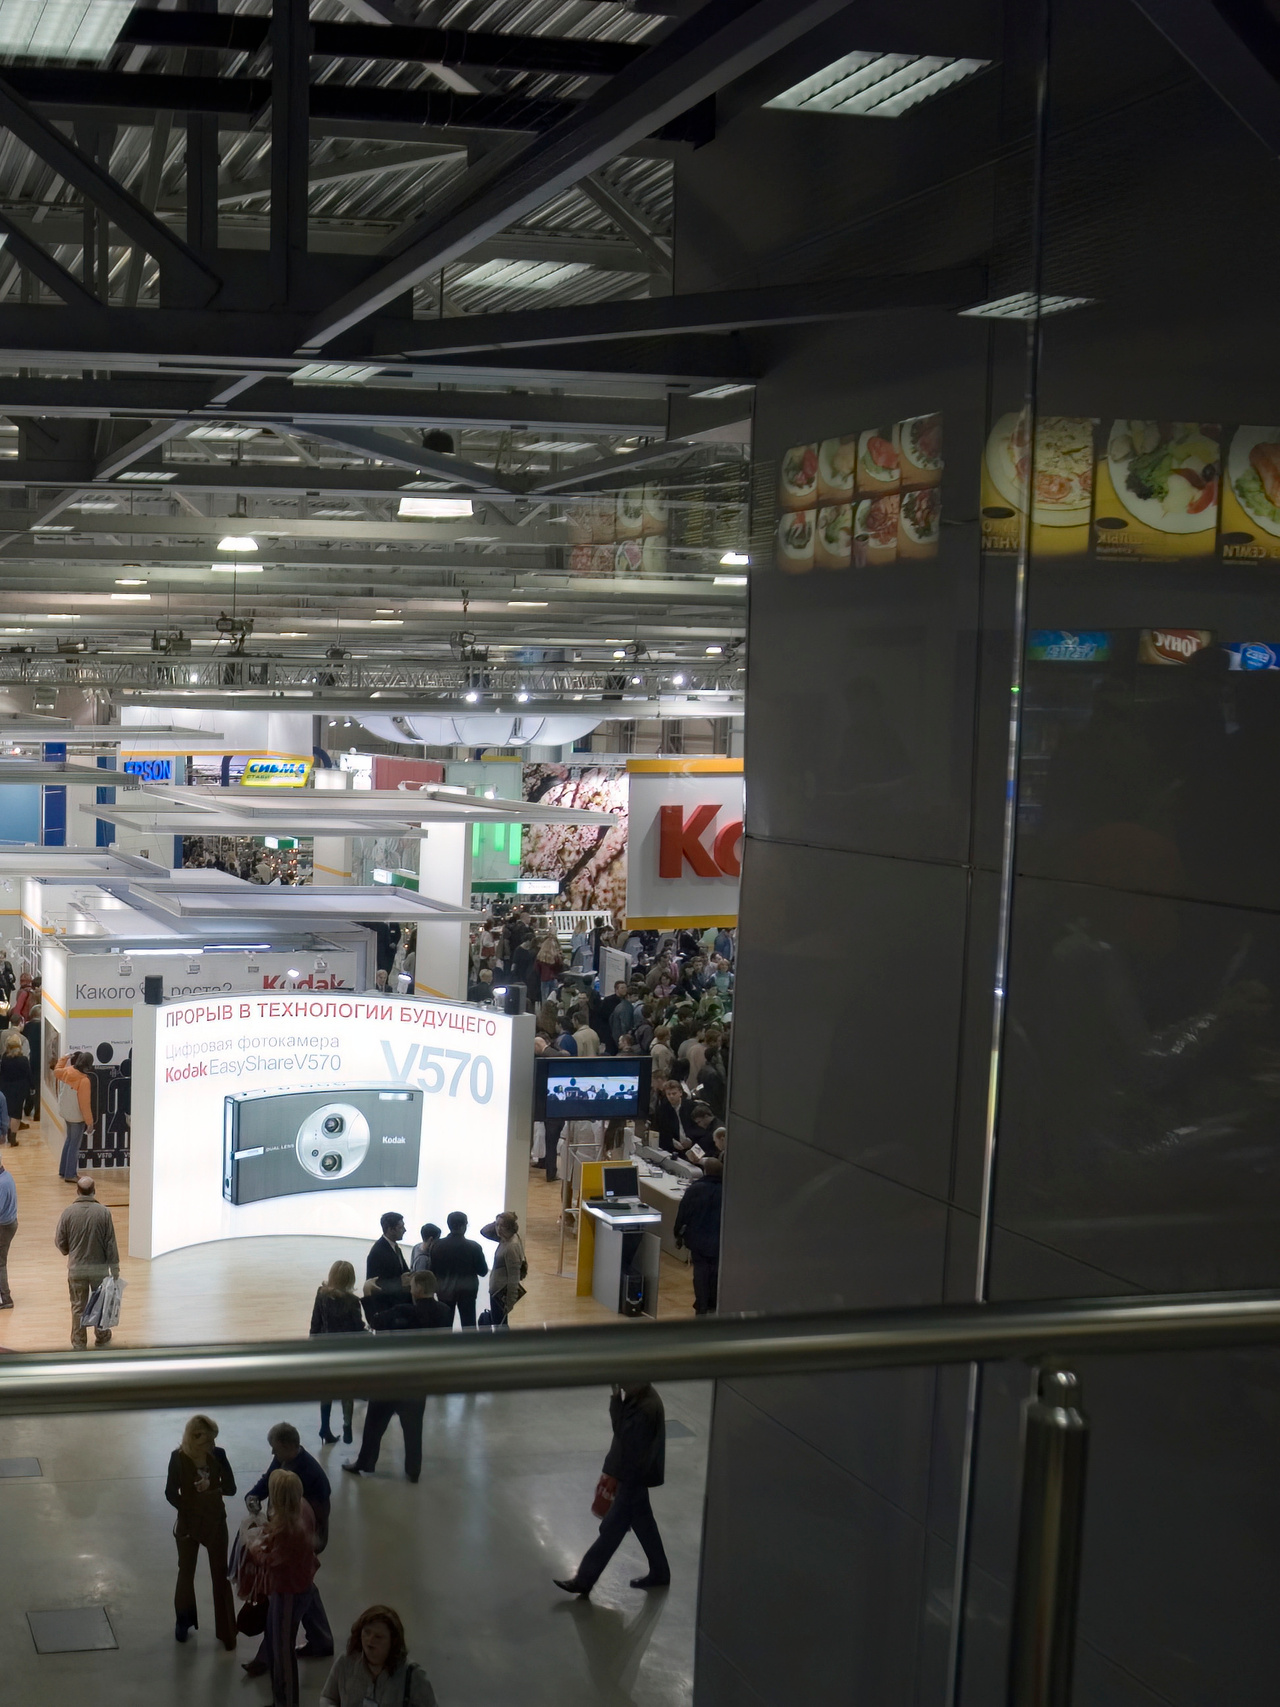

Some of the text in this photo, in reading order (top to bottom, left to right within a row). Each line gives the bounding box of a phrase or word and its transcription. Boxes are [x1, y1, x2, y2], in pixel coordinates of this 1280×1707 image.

[123, 760, 172, 782] EPSON
[75, 983, 136, 1000] Какого
[166, 1002, 497, 1036] ПРОРЫВ В ТЕХНОЛОГИИ БУДУЩЕГО
[165, 1035, 340, 1061] Цифровая фотокамера
[165, 1061, 208, 1083] Kodak
[380, 1039, 494, 1105] V570
[382, 1135, 406, 1144] Kodak
